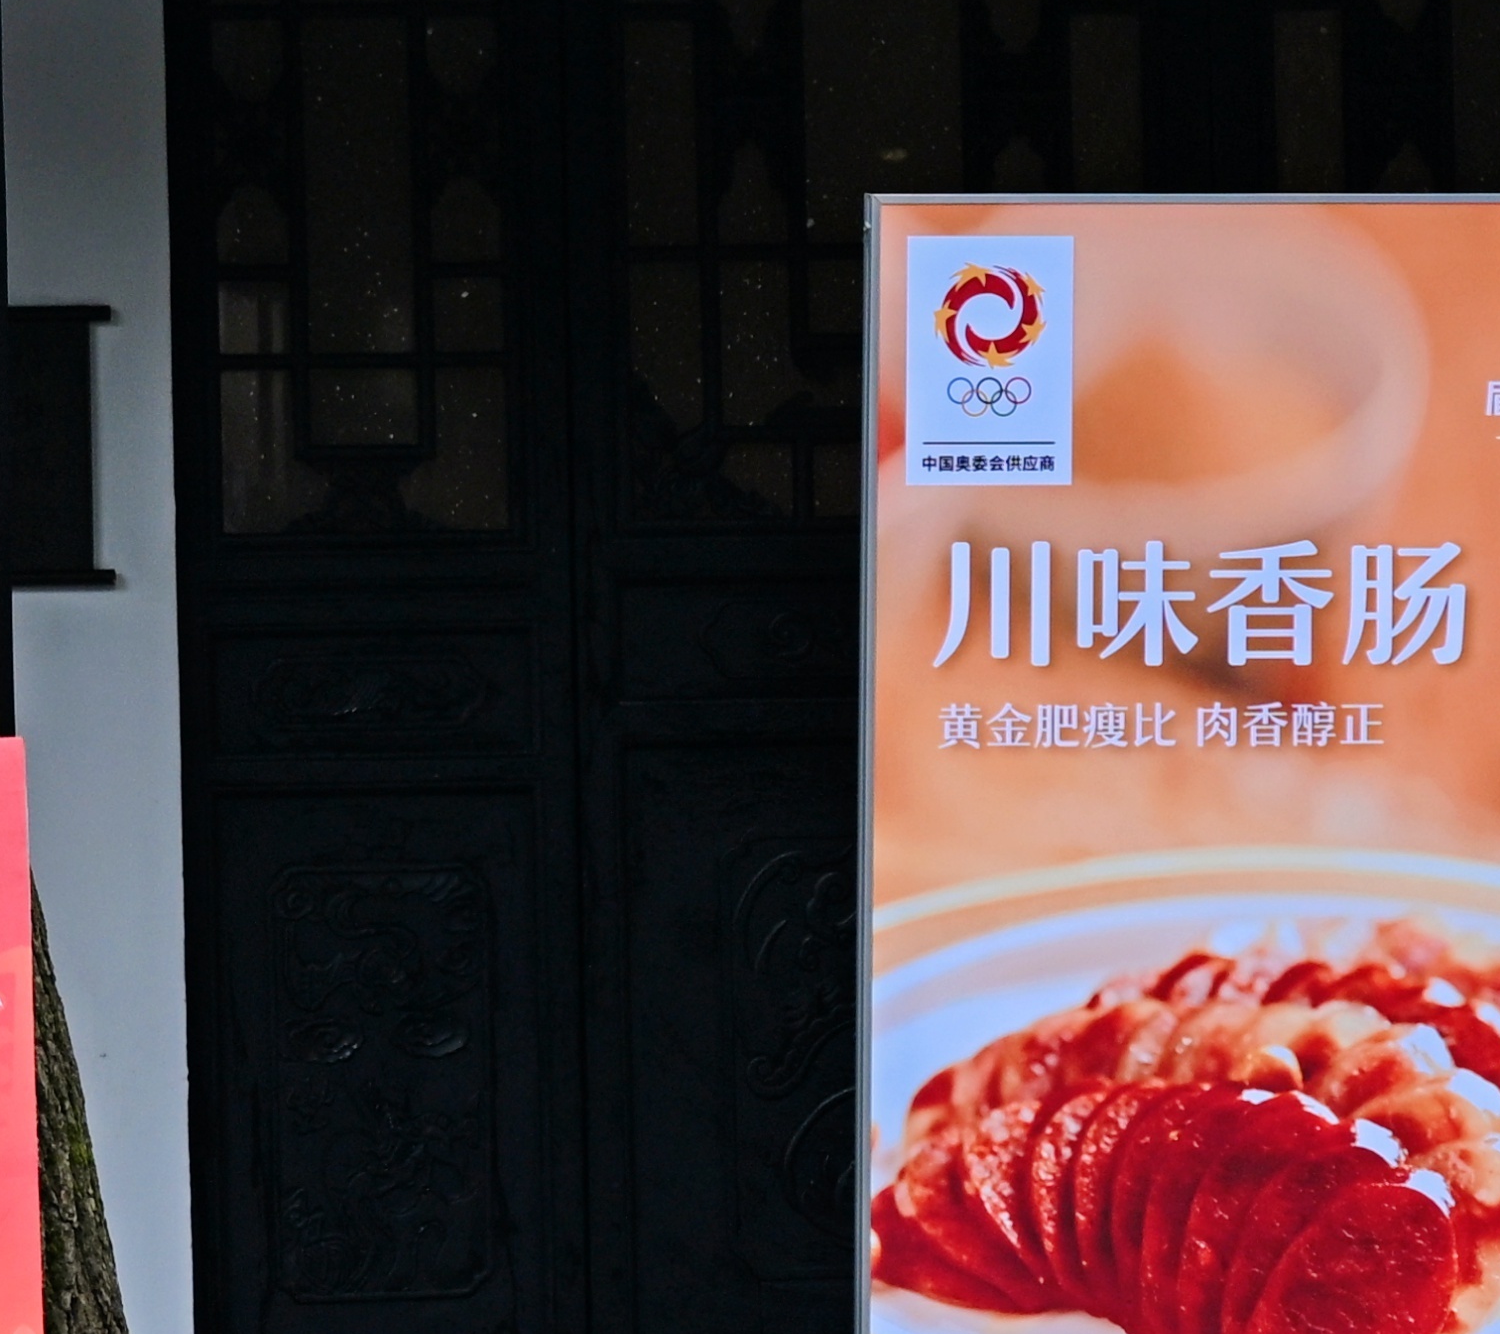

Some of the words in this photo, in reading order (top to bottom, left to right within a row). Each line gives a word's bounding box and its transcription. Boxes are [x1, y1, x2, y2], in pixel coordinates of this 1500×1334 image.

[922, 455, 1055, 472] 中国奥委会供应商
[933, 539, 1468, 668] 川味香肠
[937, 703, 1177, 750] 黄金肥瘦比
[1196, 702, 1386, 749] 肉香醇正
